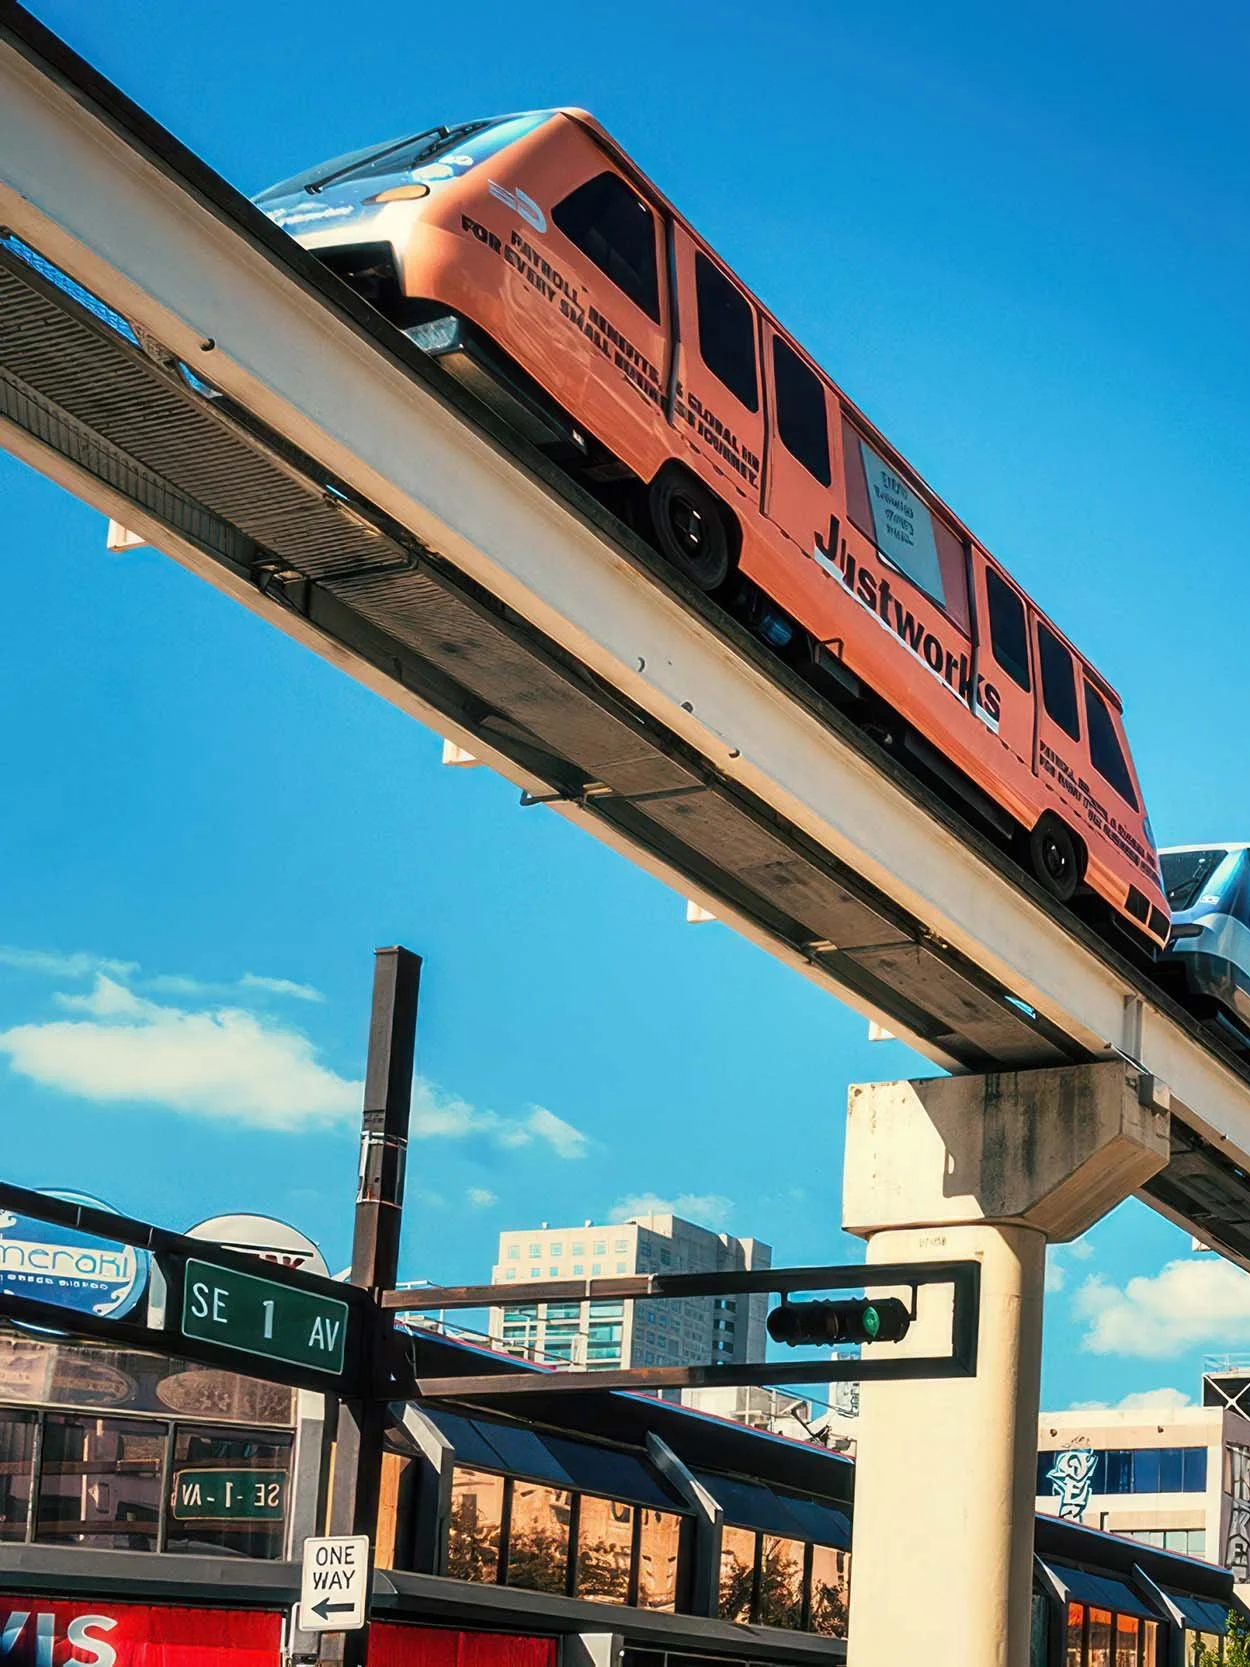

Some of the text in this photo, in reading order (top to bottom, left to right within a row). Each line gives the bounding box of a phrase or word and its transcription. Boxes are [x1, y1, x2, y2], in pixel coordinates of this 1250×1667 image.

[460, 213, 502, 255] FOR
[504, 244, 557, 303] EVERY
[559, 298, 612, 360] SMALL
[814, 513, 1001, 722] Justworks
[191, 1282, 340, 1352] SE 1 AV
[313, 1569, 356, 1590] WAY
[315, 1545, 355, 1566] ONE
